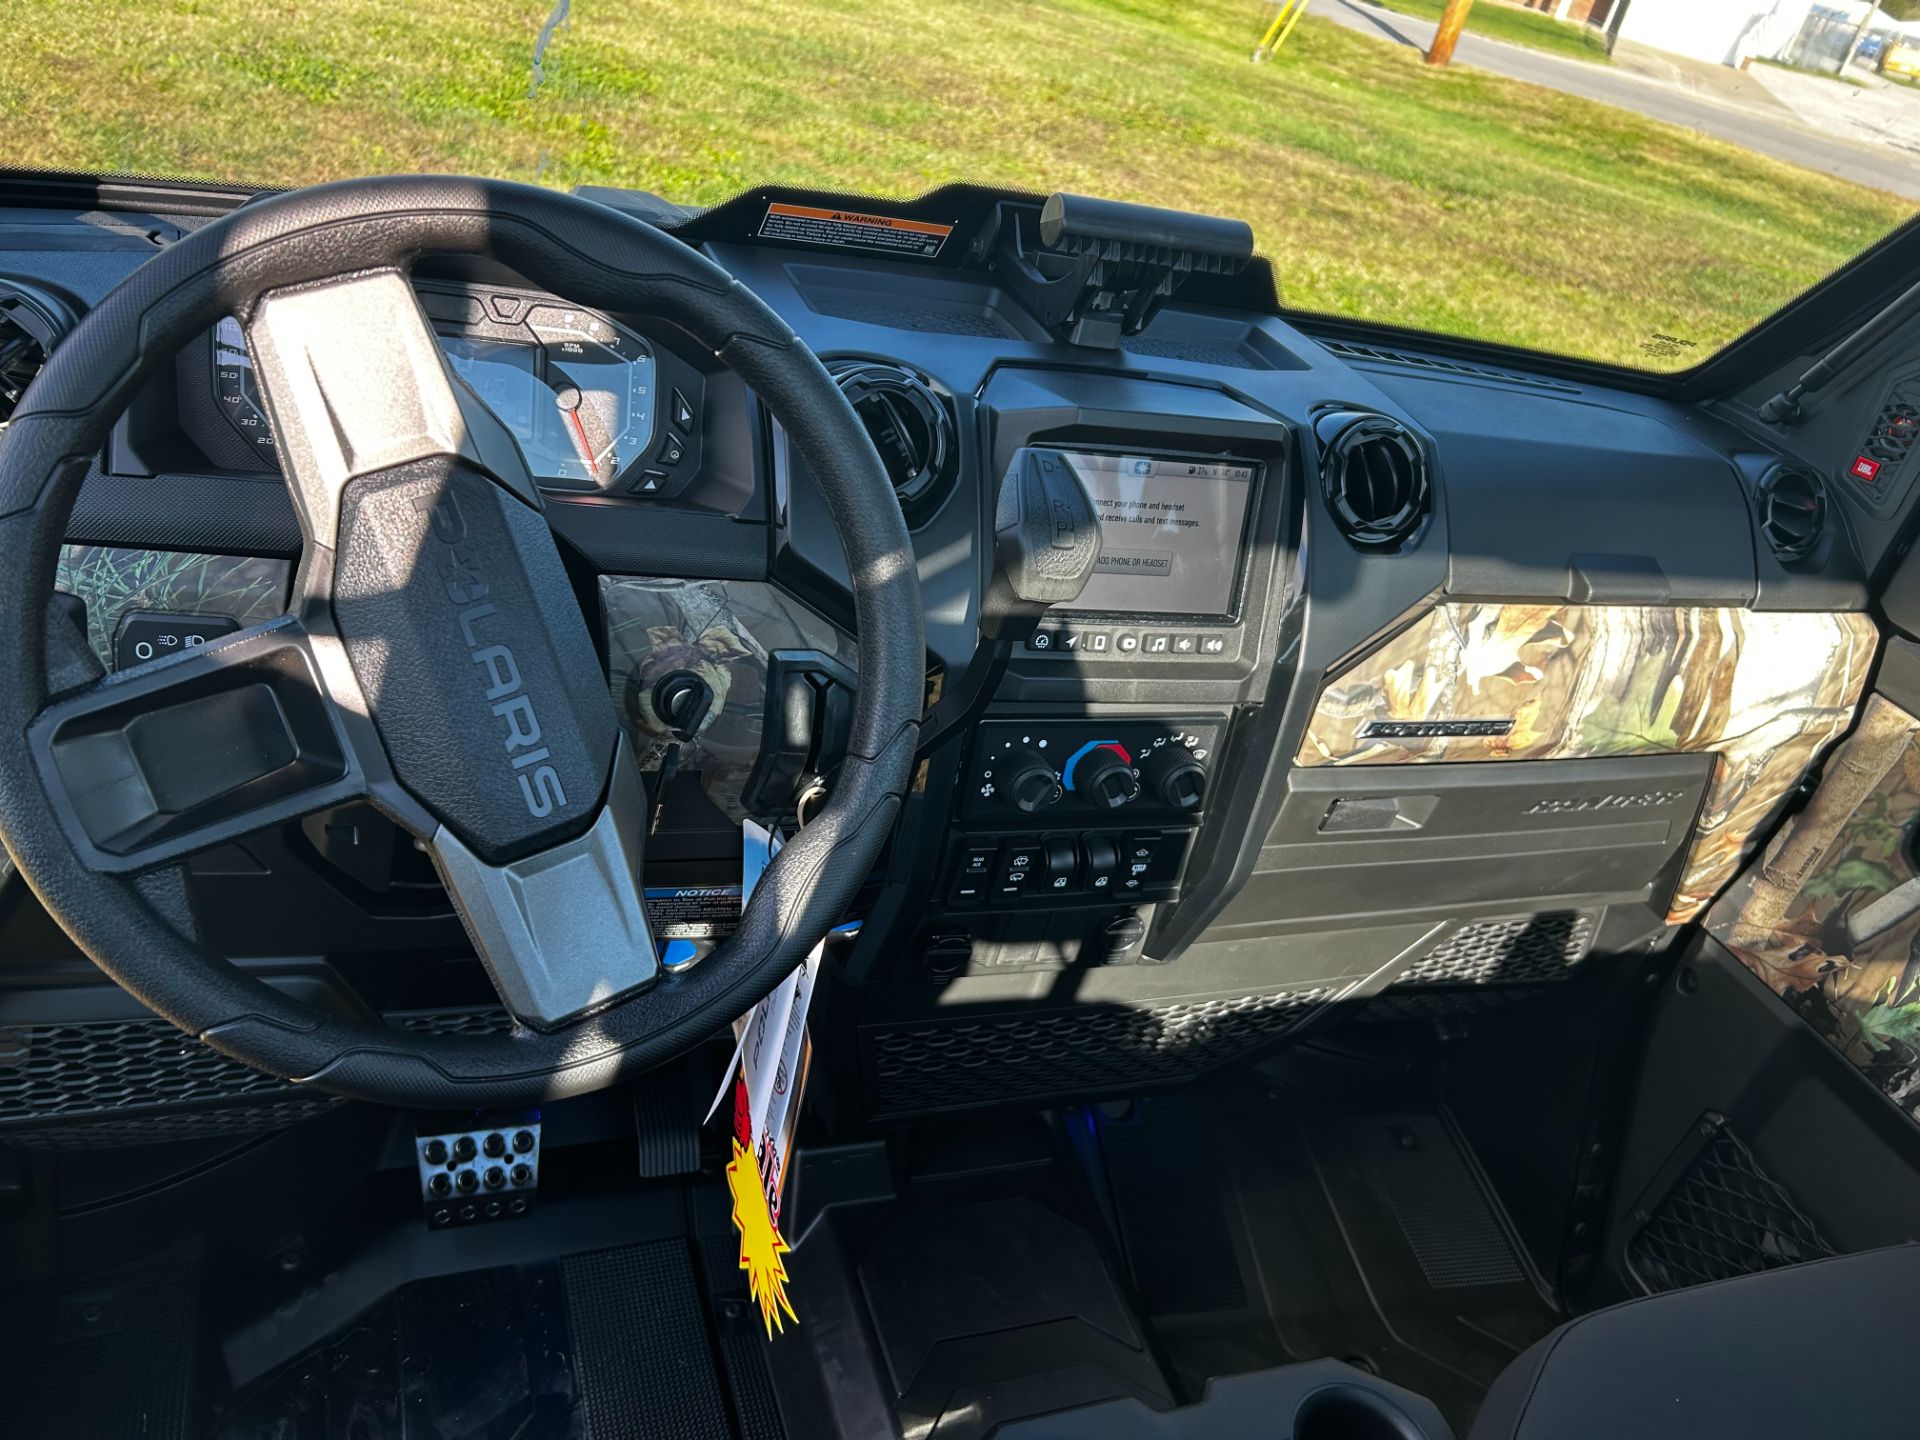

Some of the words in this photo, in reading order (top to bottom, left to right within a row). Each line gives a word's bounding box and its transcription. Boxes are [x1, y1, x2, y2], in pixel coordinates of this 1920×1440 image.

[844, 214, 892, 226] WARNING
[636, 354, 647, 363] 6
[220, 371, 237, 379] 50
[637, 386, 647, 395] 5
[223, 395, 240, 404] 40
[636, 412, 645, 420] 4
[240, 418, 257, 426] 30
[257, 437, 274, 445] 20
[628, 437, 637, 445] 3
[610, 456, 620, 465] 2
[1857, 462, 1872, 475] JBL
[1113, 500, 1128, 509] your
[1128, 499, 1148, 510] phone
[1148, 501, 1160, 511] and
[1160, 502, 1185, 513] headset
[1105, 513, 1127, 523] receive
[1128, 515, 1143, 524] calls
[1144, 516, 1156, 525] and
[1156, 517, 1168, 526] text
[1056, 521, 1068, 538] P
[1110, 556, 1131, 567] PHONE
[1132, 557, 1141, 568] OR
[1142, 557, 1169, 569] HEADSET
[412, 486, 568, 818] POLARIS
[675, 888, 731, 897] NOTICE
